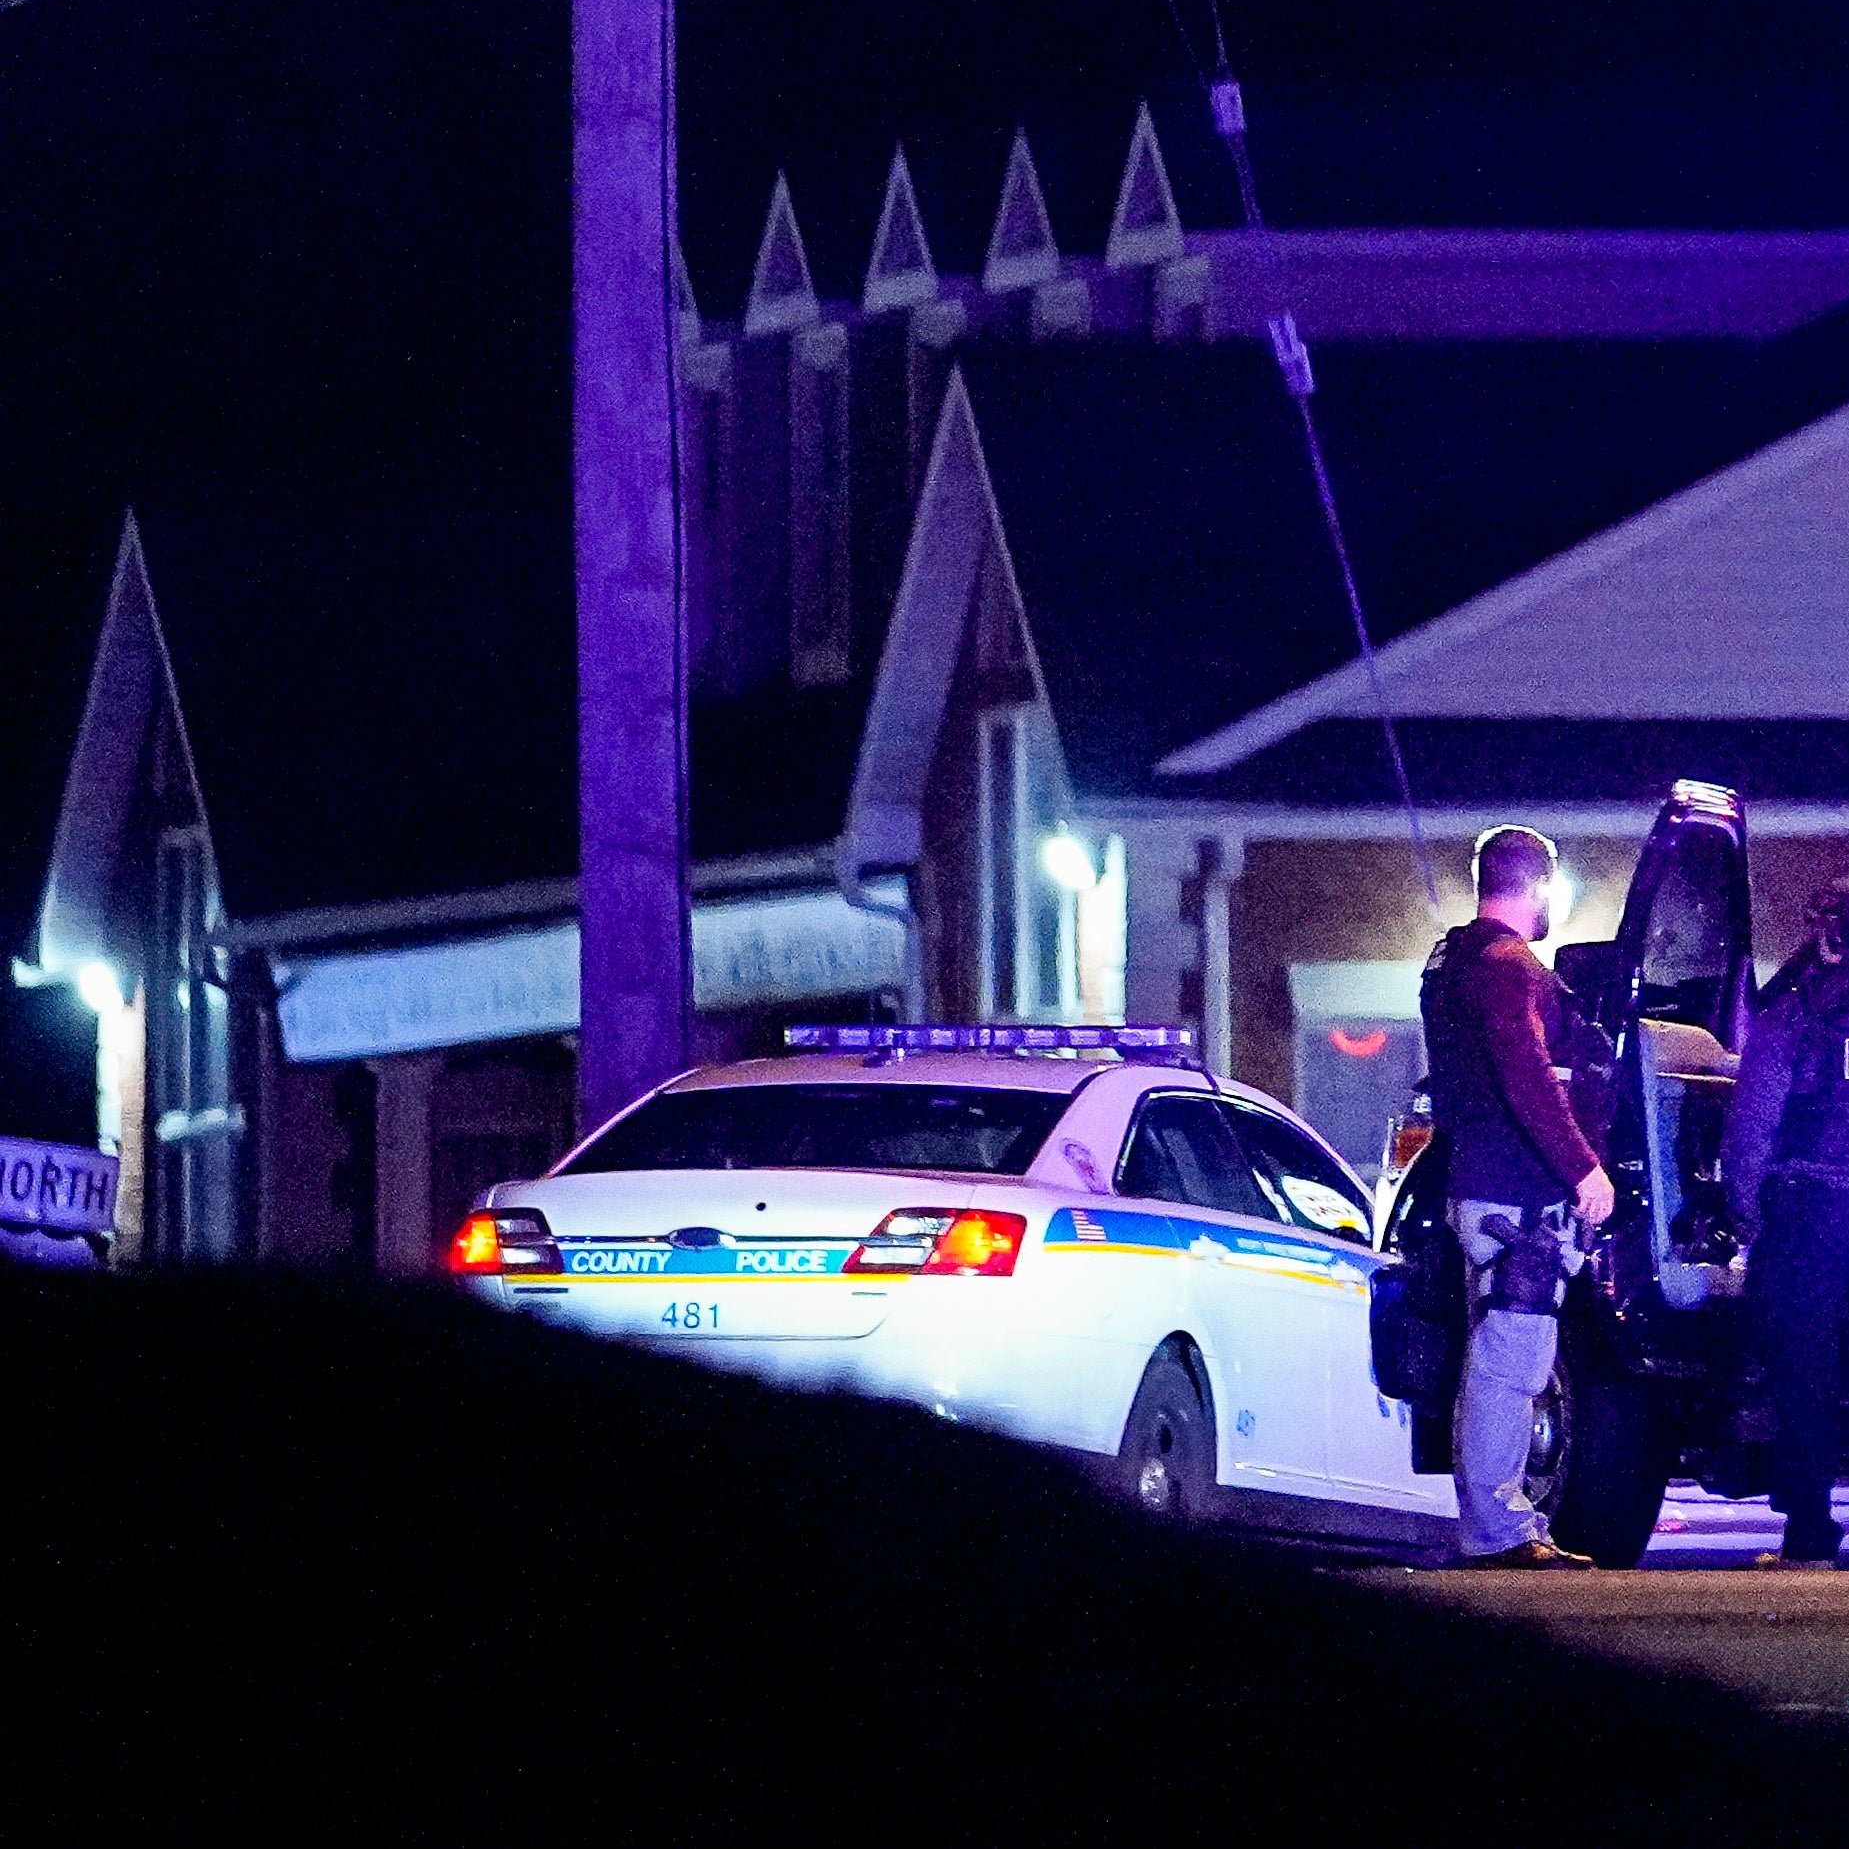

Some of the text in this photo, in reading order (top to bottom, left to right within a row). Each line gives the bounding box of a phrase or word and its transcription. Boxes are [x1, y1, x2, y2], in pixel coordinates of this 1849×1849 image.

[0, 1155, 109, 1211] ORTH
[571, 1250, 828, 1273] COUNTY POLICE
[661, 1302, 720, 1329] 481
